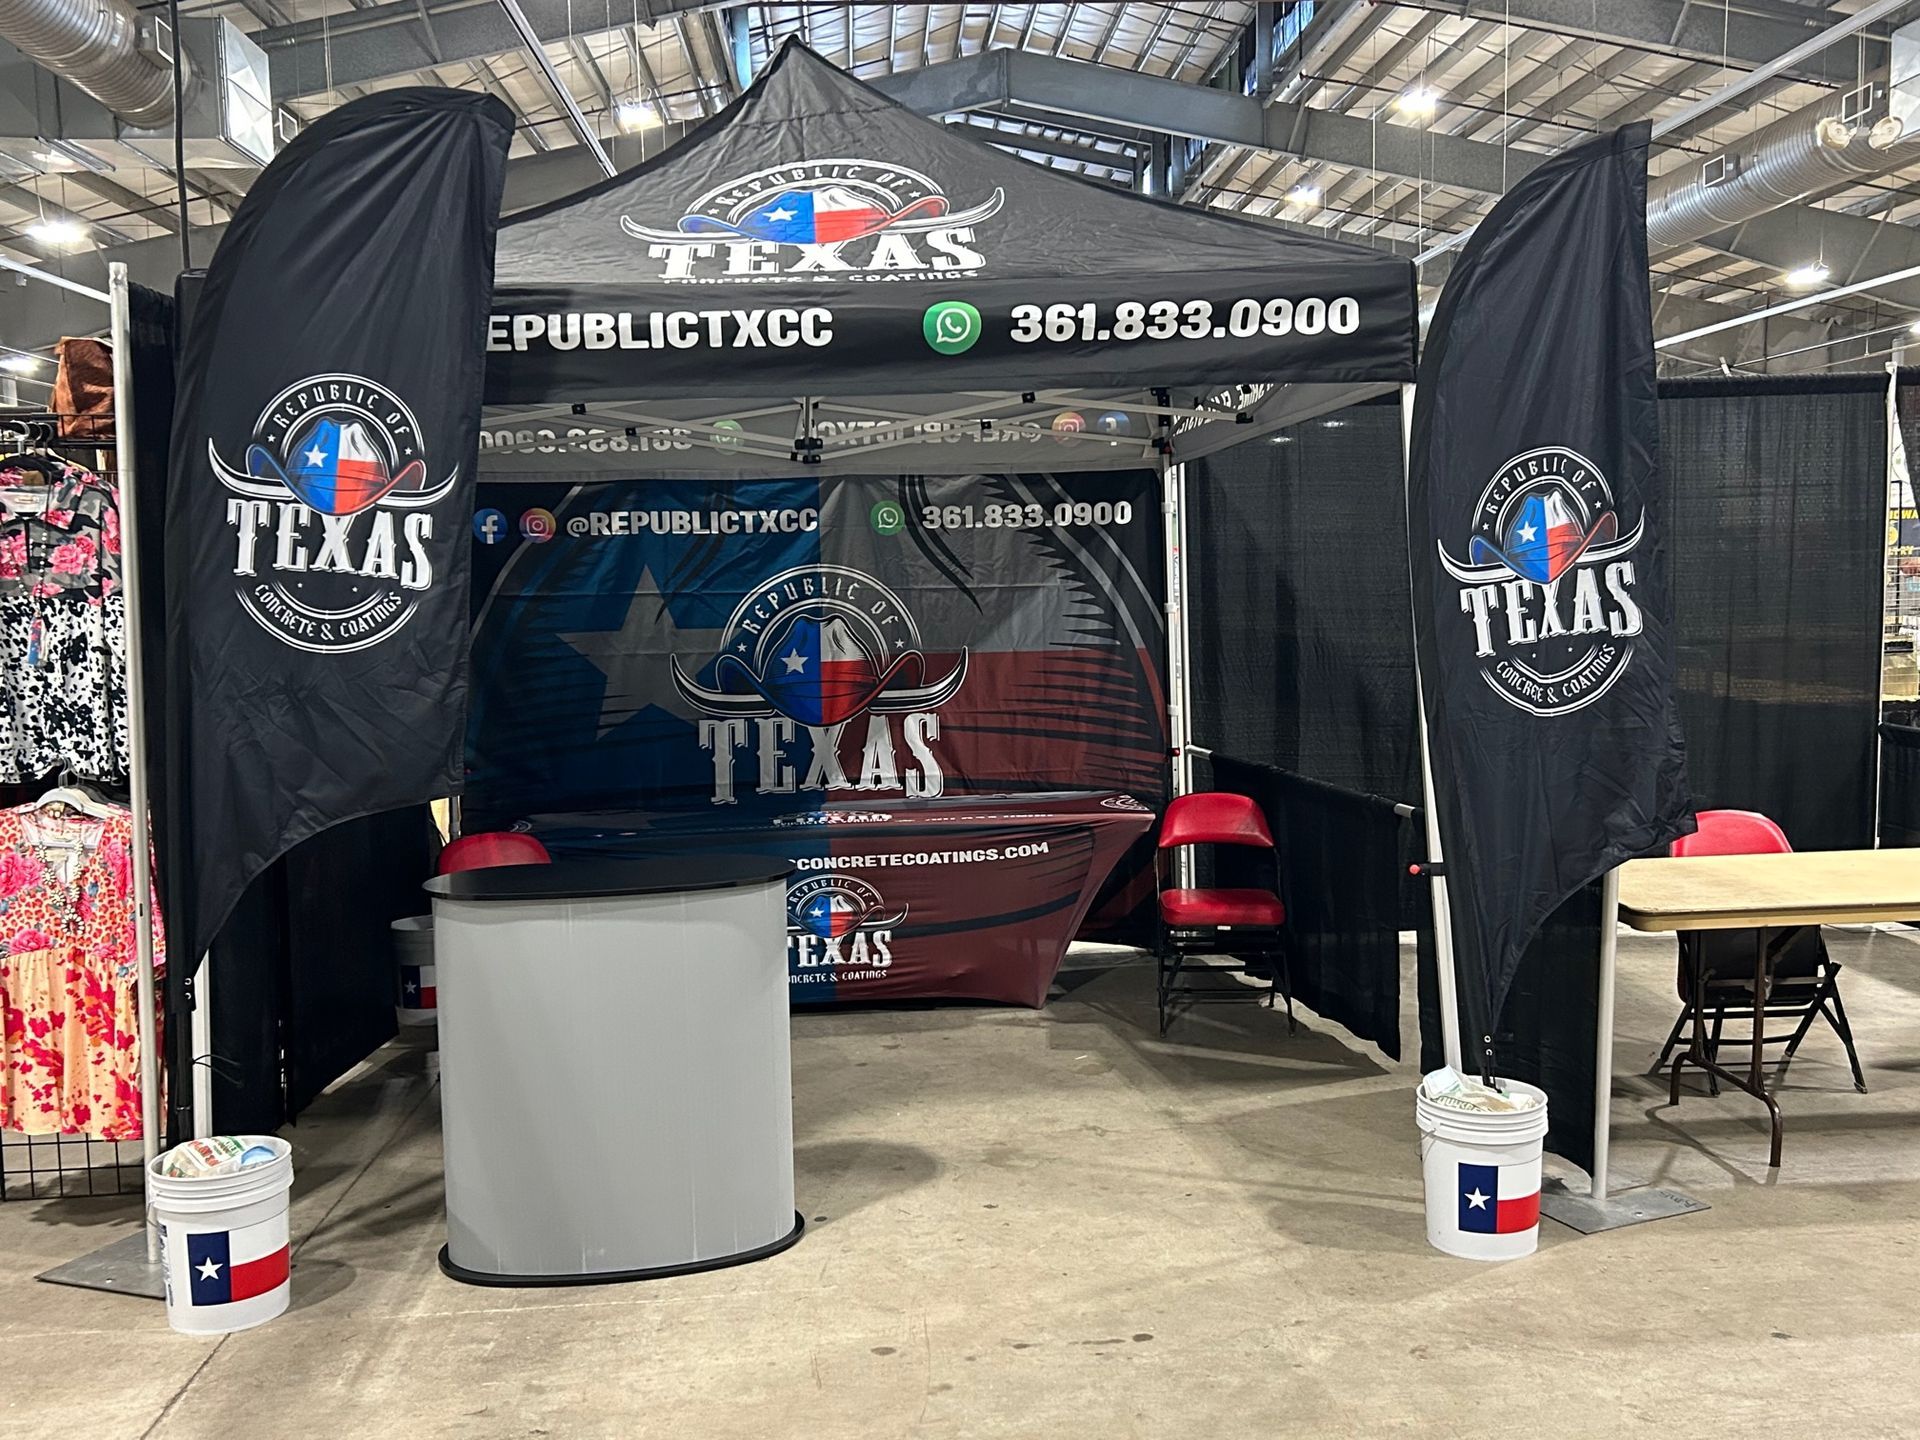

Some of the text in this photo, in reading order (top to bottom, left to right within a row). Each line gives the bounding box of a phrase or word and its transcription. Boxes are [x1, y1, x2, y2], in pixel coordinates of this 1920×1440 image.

[715, 165, 912, 206] REPUBLIC OF
[648, 227, 986, 279] TEXAS
[849, 270, 979, 283] COATINGS
[487, 296, 1361, 351] EPUBLICTXCC 361.833.0900
[273, 384, 410, 435] REPUBLIC OF
[1485, 457, 1596, 515] REPUBLIC OF
[226, 498, 433, 591] TEXAS
[566, 500, 1132, 537] @REPUBLICTXCC 361.833.0900
[255, 584, 402, 641] CONCRETE & COATINGS
[742, 576, 900, 634] REPUBLIC OF
[1460, 561, 1643, 657] TEXAS
[1547, 687, 1559, 703] &
[1562, 643, 1615, 697] COATINGS
[698, 712, 944, 805] TEXAS
[788, 841, 1049, 871] CONCRETECOATINGS.COM
[789, 879, 872, 903] REPUBLIC OF
[788, 970, 887, 984] NCRETE & COATINGS
